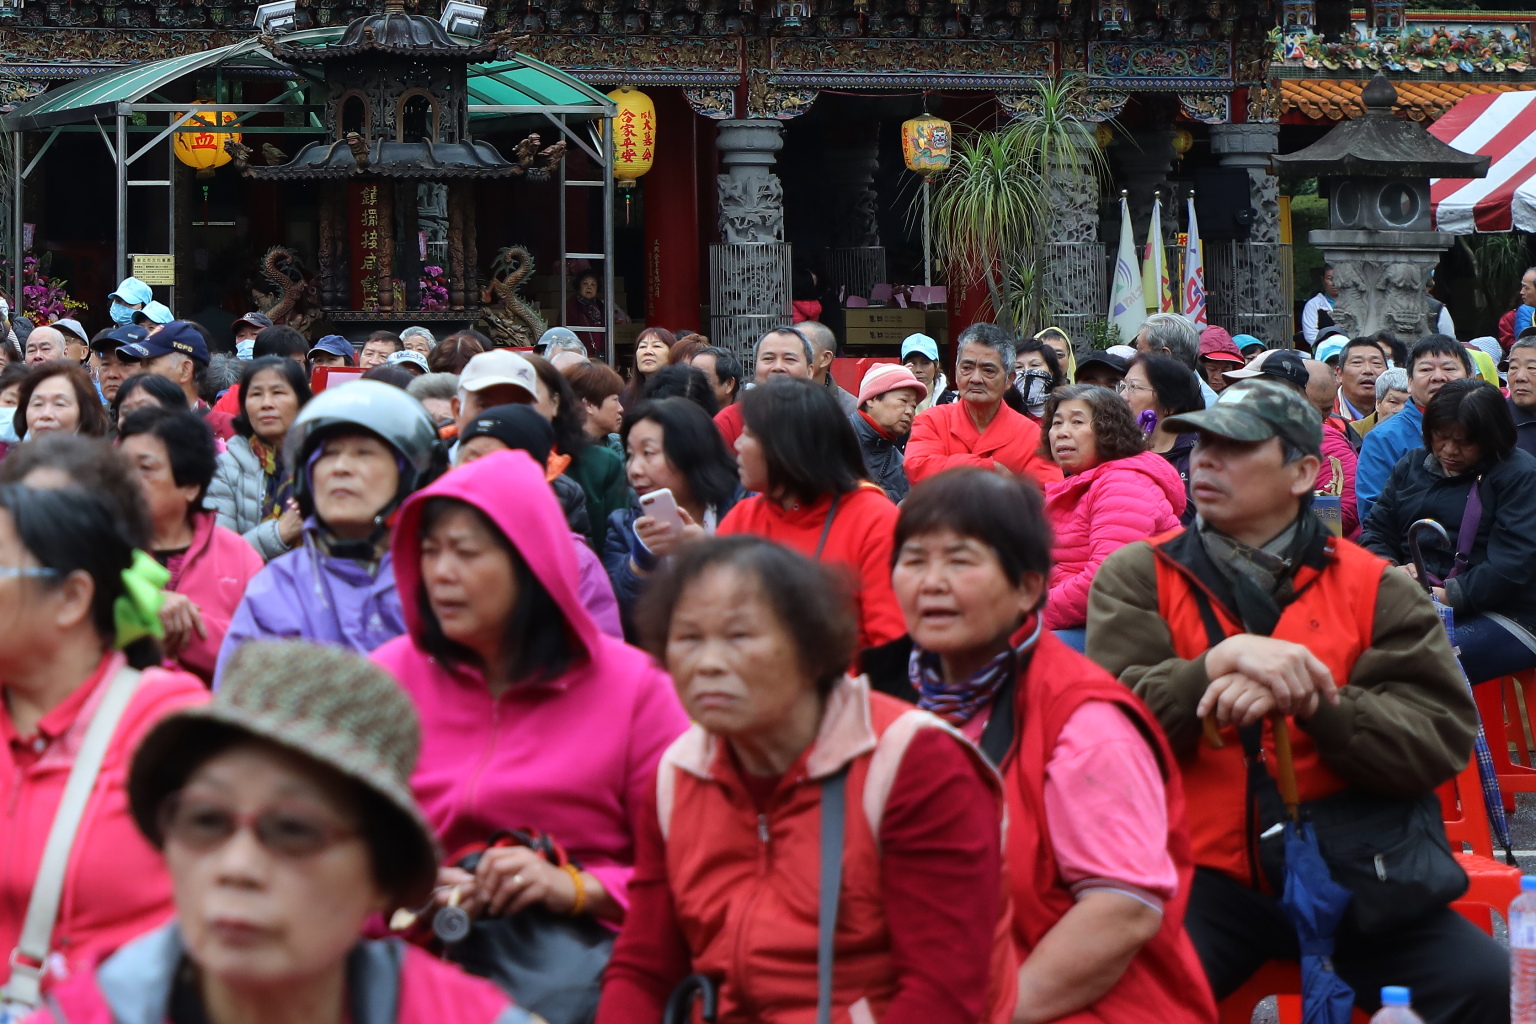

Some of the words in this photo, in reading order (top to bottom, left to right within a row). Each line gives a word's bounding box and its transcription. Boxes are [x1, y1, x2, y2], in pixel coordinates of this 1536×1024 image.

[618, 108, 638, 163] 合家平安
[642, 119, 654, 162] 大墓公
